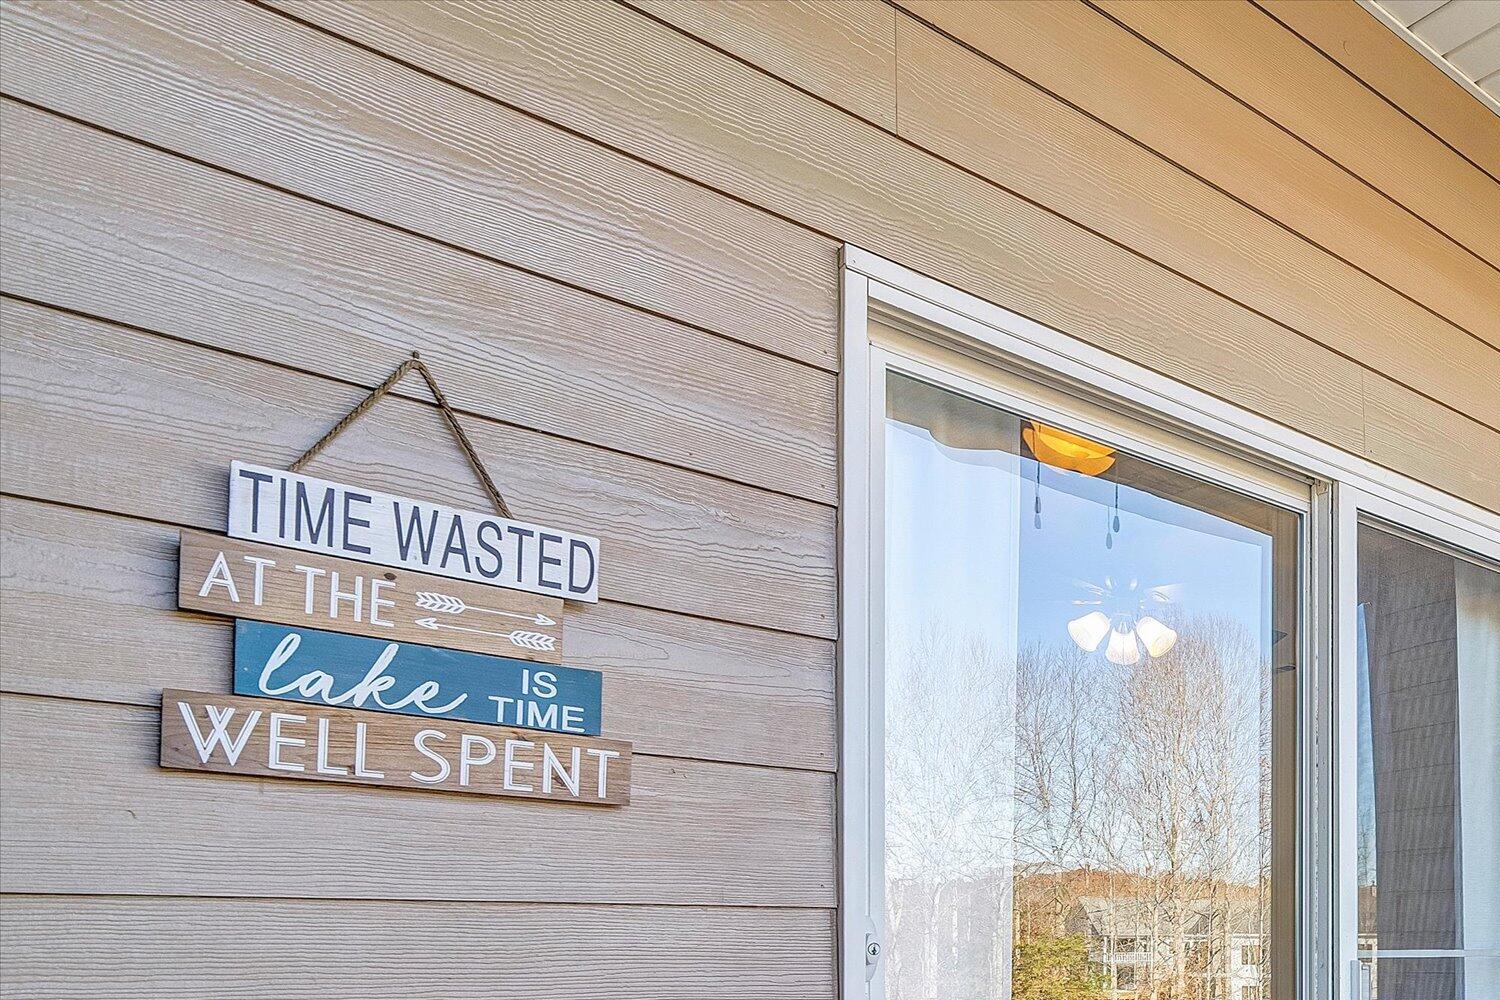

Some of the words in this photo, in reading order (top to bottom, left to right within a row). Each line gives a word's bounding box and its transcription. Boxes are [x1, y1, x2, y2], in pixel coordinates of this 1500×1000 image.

[239, 469, 372, 555] TIME
[393, 502, 596, 595] WASTED
[198, 552, 276, 606] AT
[294, 565, 397, 628] THE
[258, 633, 467, 714] lake
[521, 669, 557, 698] IS
[177, 701, 385, 779] WELL
[410, 729, 620, 799] SPENT
[488, 695, 585, 734] TIME
